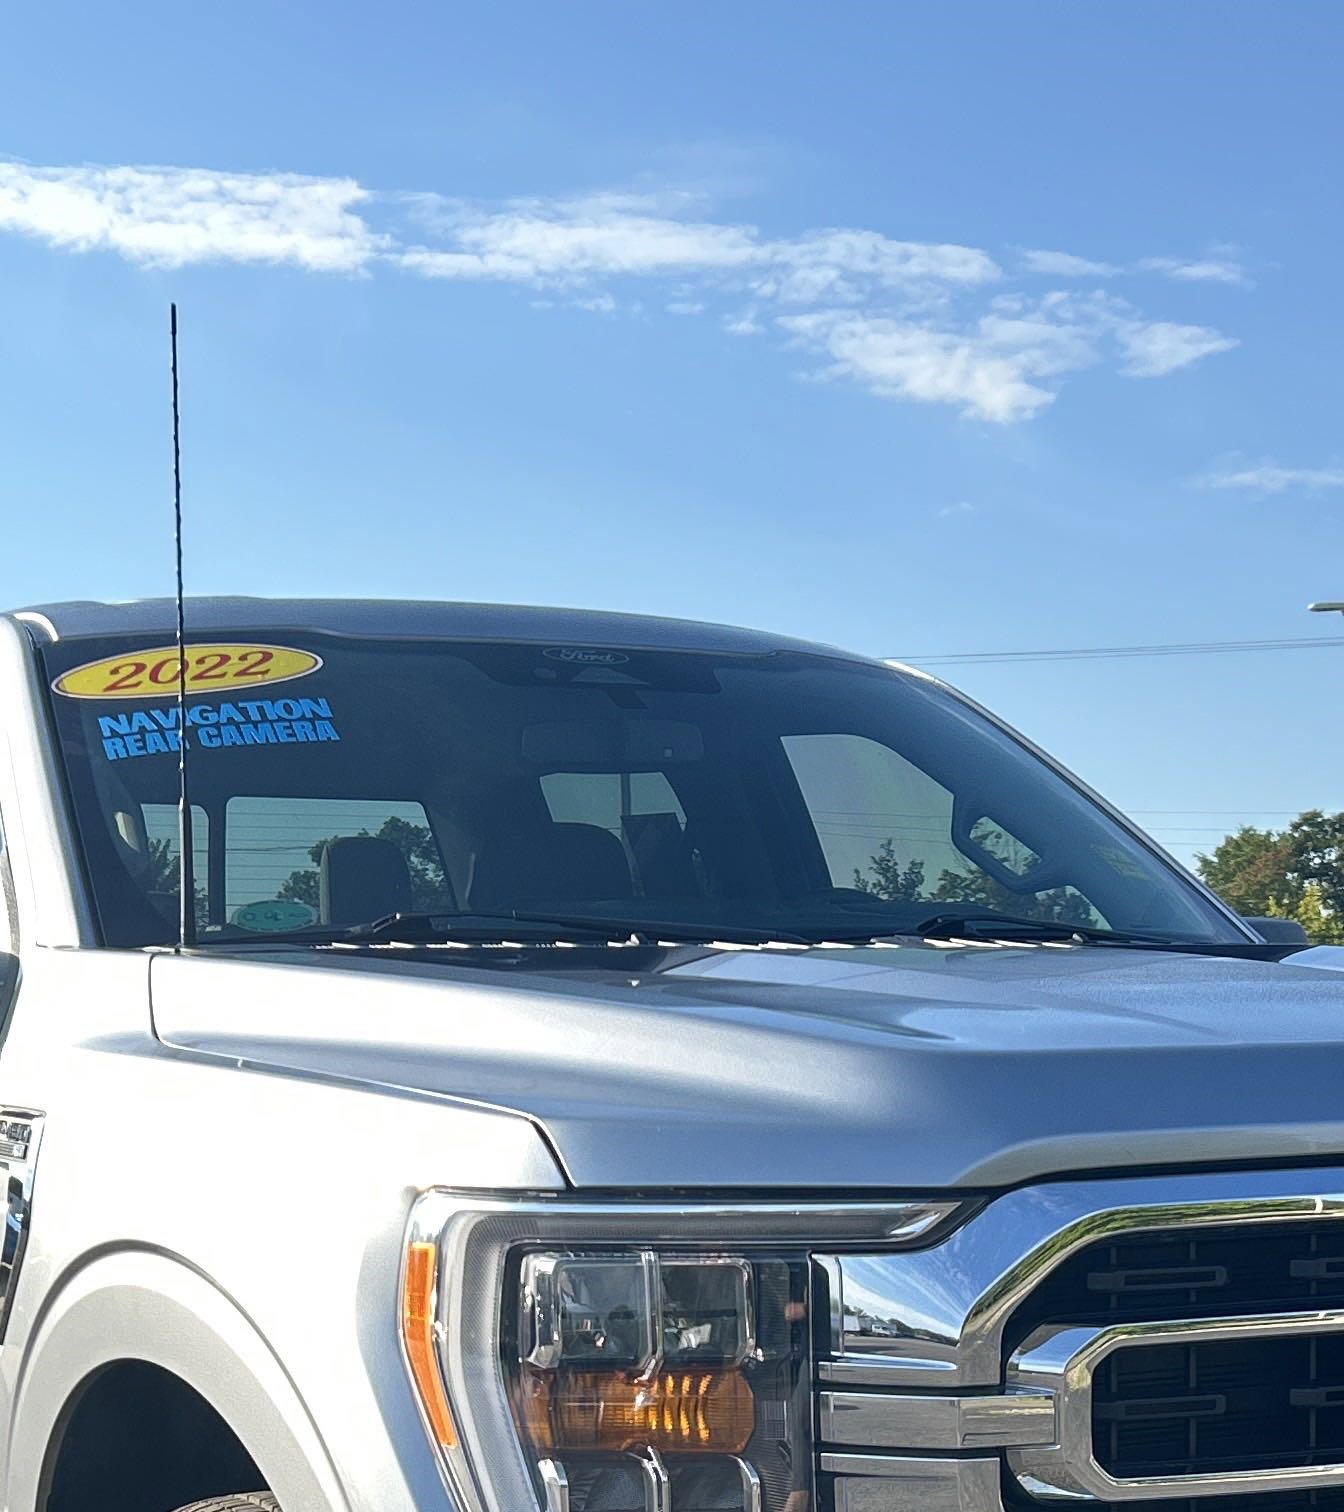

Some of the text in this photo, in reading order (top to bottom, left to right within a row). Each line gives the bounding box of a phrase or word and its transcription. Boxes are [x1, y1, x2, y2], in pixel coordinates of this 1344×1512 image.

[102, 650, 274, 693] 2022
[97, 697, 334, 738] NAVIGATION
[197, 719, 341, 749] CAMERA
